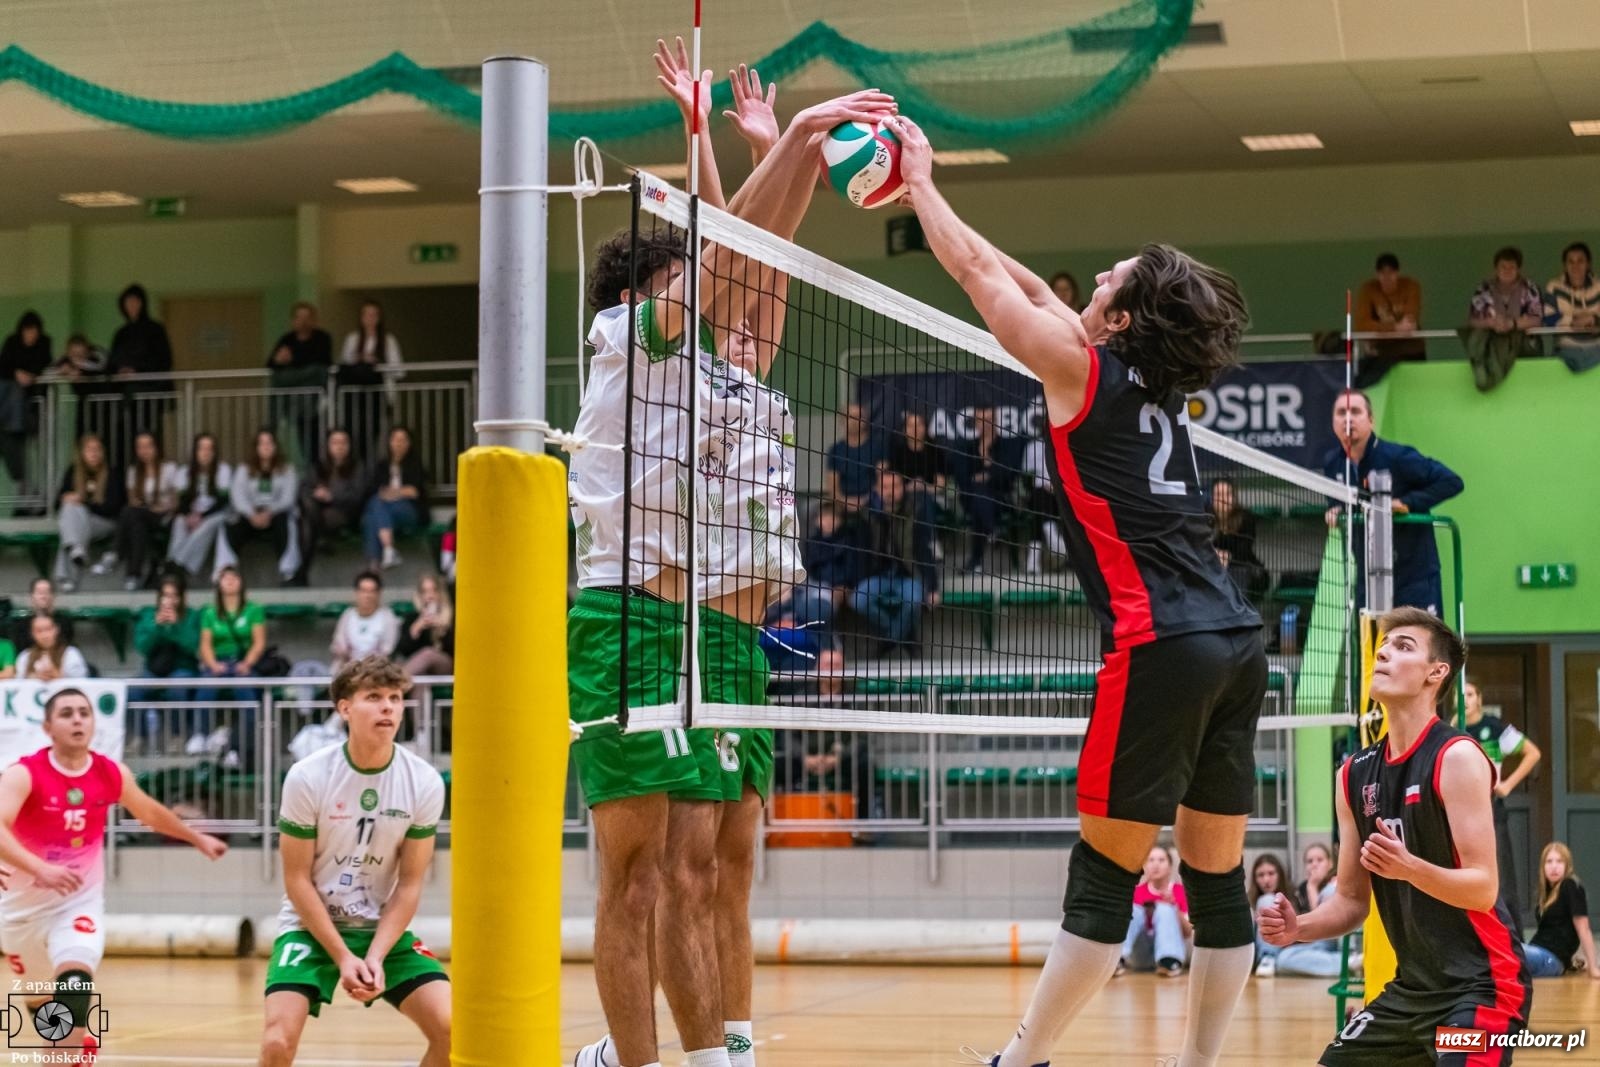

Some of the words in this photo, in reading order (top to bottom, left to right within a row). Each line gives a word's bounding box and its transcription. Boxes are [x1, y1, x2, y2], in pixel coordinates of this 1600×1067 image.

[63, 809, 87, 832] 15
[356, 817, 375, 845] 17
[278, 942, 312, 968] 17
